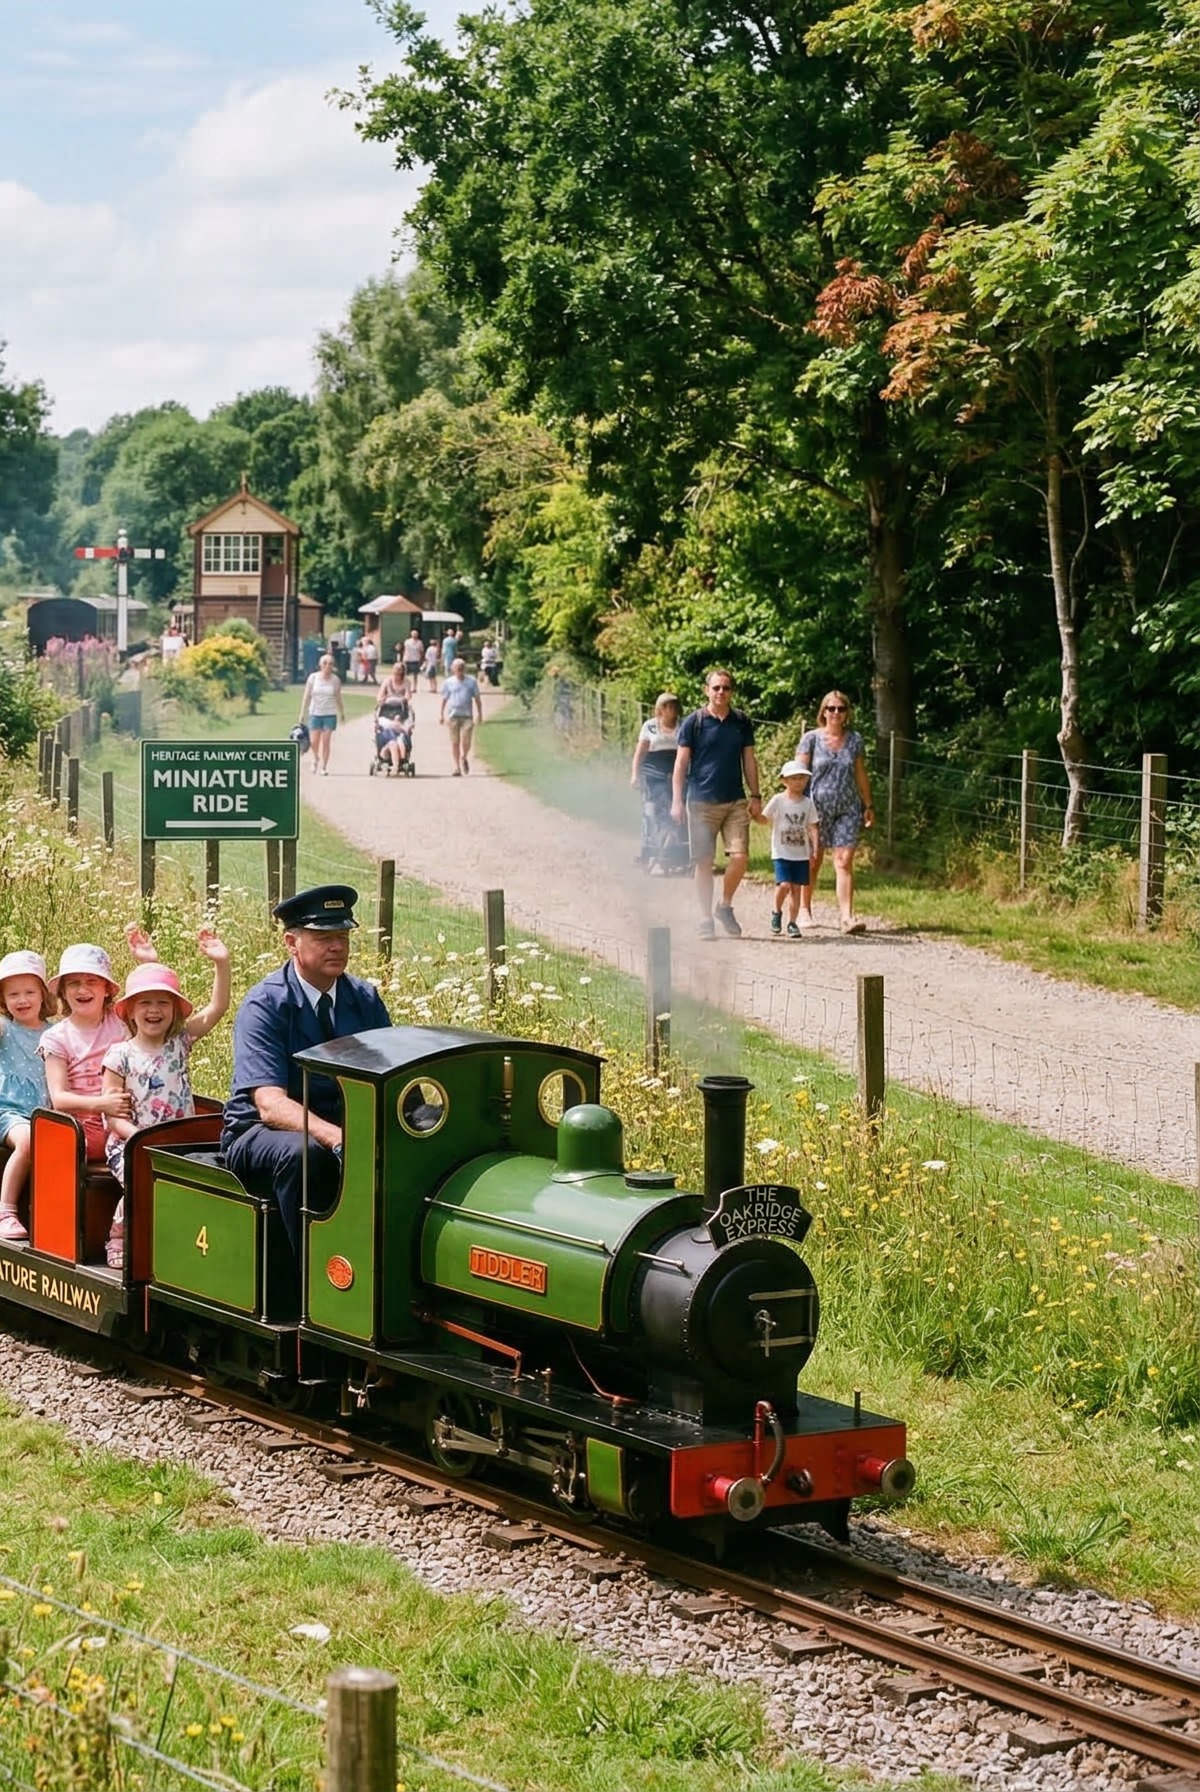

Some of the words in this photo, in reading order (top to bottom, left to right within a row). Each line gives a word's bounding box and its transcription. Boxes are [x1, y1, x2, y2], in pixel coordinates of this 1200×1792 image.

[151, 751, 200, 761] HERITAGE
[203, 751, 247, 761] RAILWAY
[249, 751, 291, 761] CENTRE
[153, 769, 288, 788] MINIATURE
[193, 794, 249, 813] RIDE
[744, 1187, 778, 1202] THE
[720, 1203, 802, 1227] OAKRIDGE
[195, 1225, 209, 1256] 4
[725, 1219, 796, 1241] EXPRESS
[472, 1249, 543, 1289] TIDDLER
[41, 1274, 101, 1316] RAILWAY
